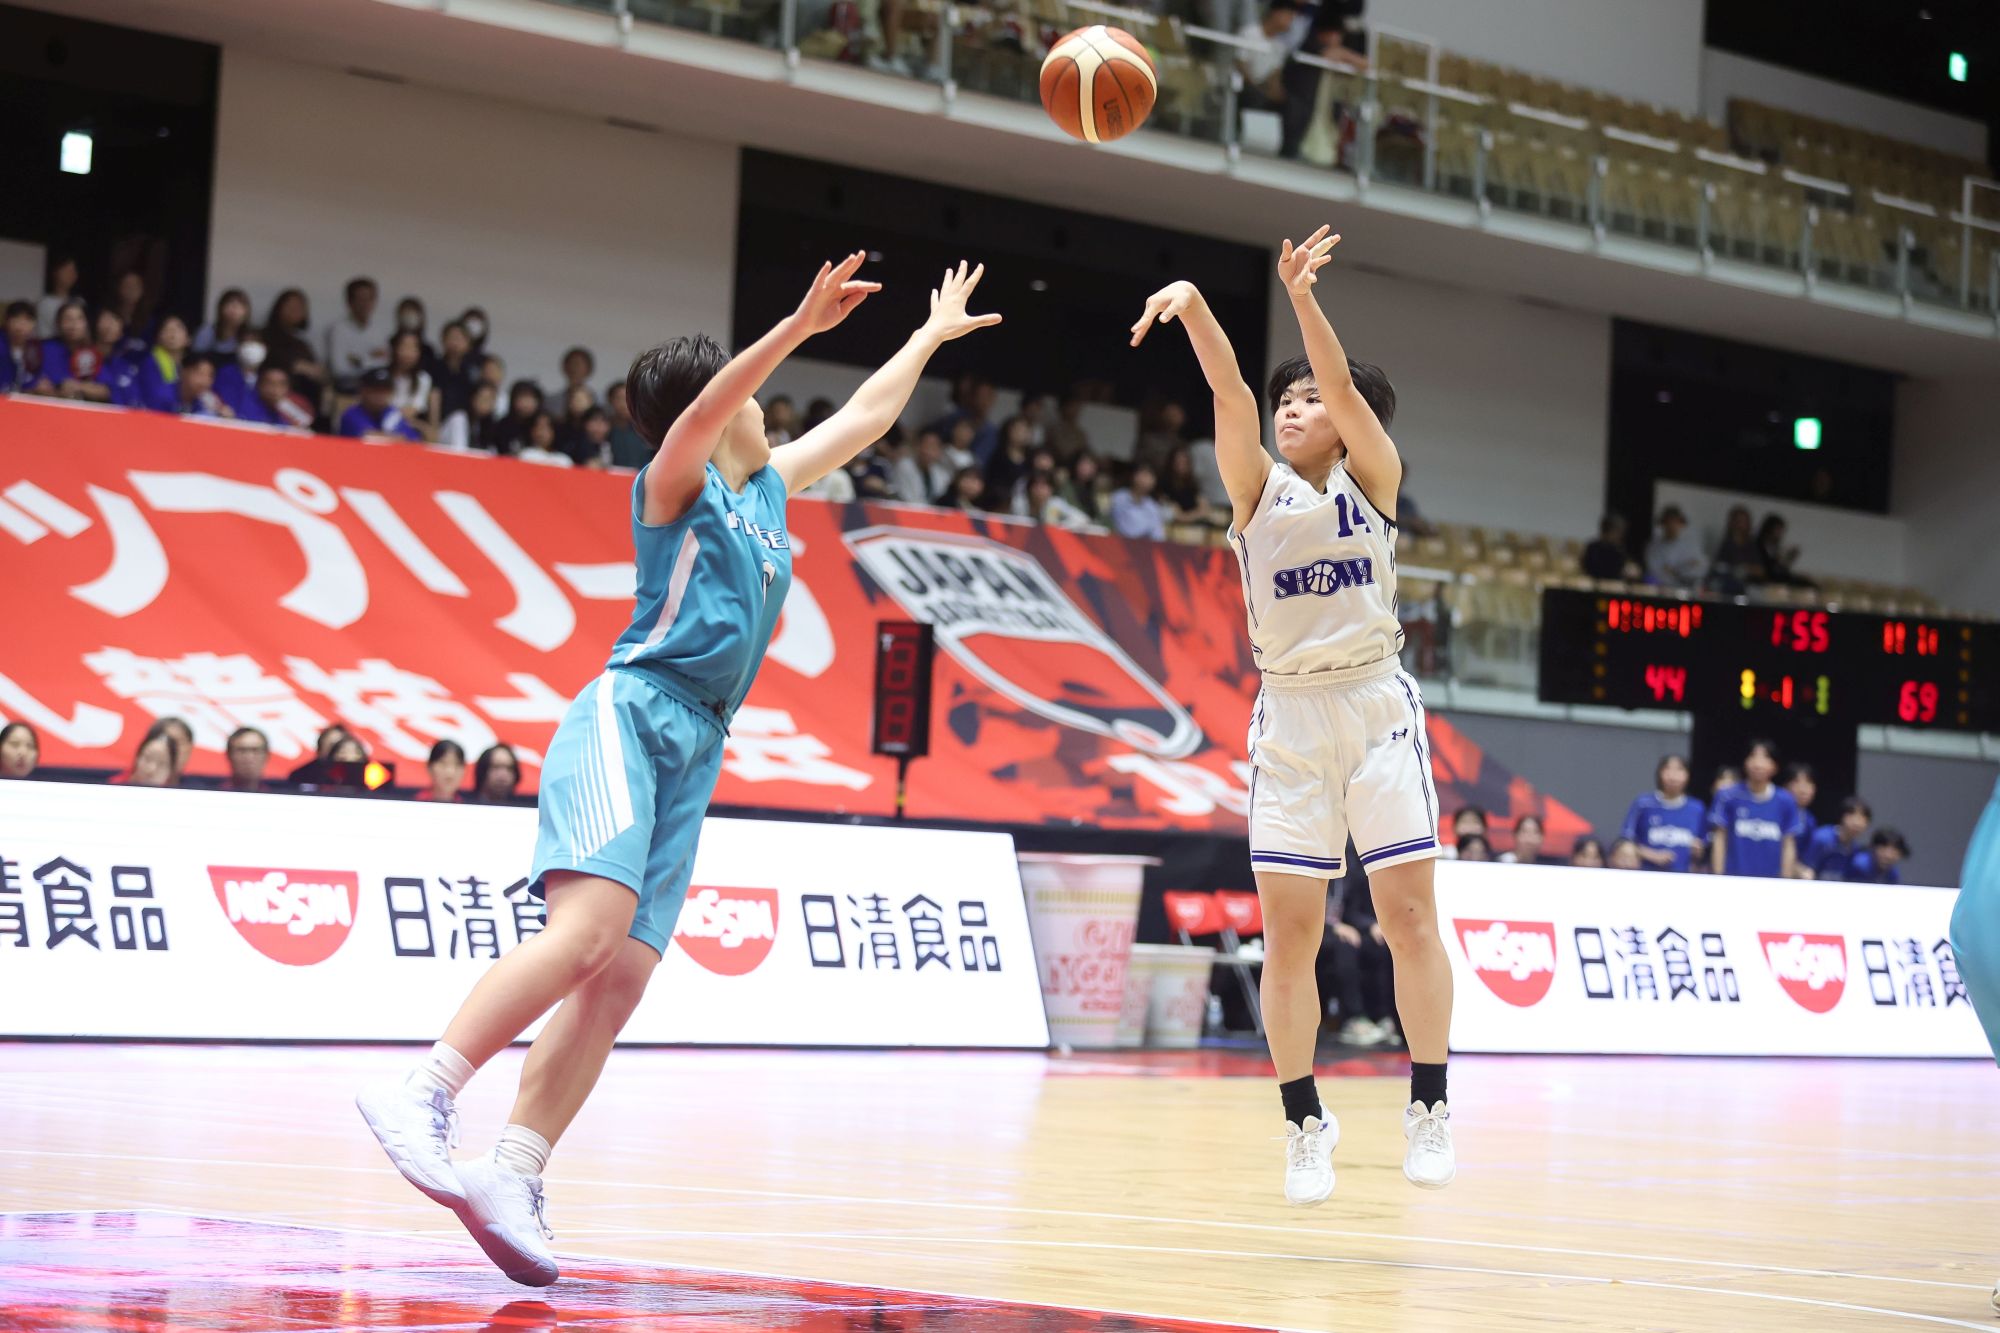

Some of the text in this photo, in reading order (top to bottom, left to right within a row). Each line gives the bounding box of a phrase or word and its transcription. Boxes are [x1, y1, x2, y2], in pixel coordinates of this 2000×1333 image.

[1335, 493, 1371, 537] 14
[887, 548, 1055, 606] JAPAN
[1273, 558, 1375, 599] SHOWA
[1645, 664, 1687, 702] 44
[1898, 680, 1939, 722] 69
[224, 872, 352, 936] NISSIN
[801, 892, 1002, 972] 日清食品
[1463, 922, 1556, 981] NISSIN
[1574, 926, 1740, 1002] 日清食品
